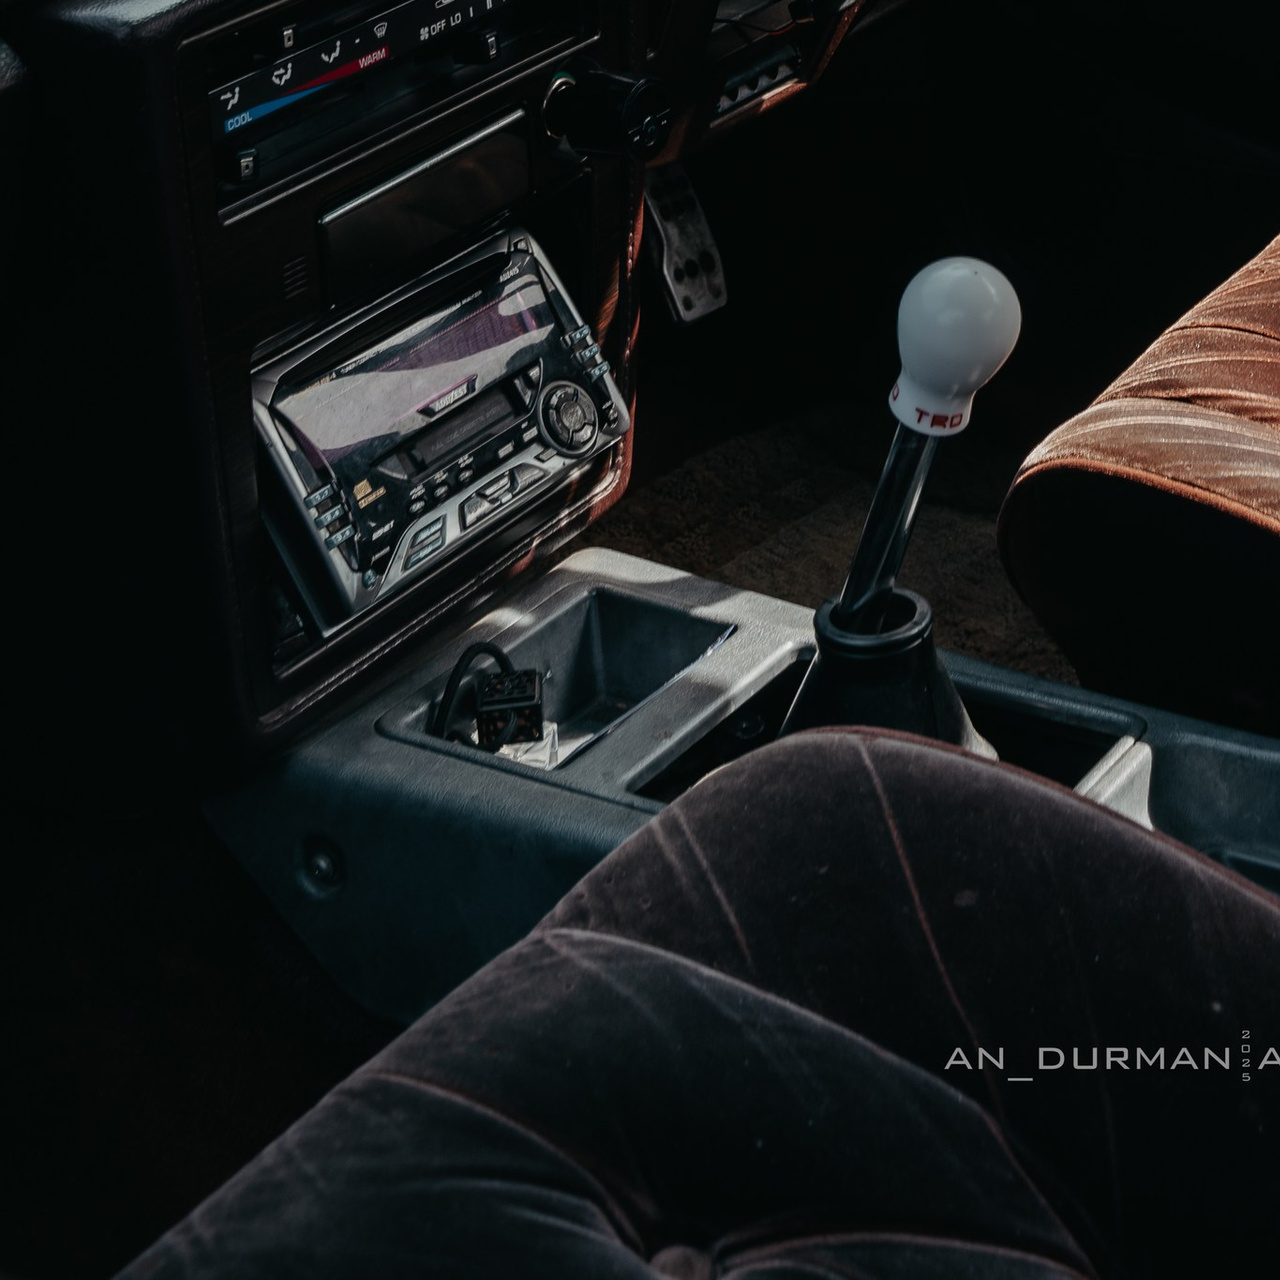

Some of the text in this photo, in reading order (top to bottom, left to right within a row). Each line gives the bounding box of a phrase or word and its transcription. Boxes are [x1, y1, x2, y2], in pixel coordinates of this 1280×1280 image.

[430, 19, 447, 36] OFF
[450, 12, 462, 27] LO
[358, 47, 387, 69] WARM
[227, 111, 253, 132] COOL
[915, 407, 964, 430] TRD
